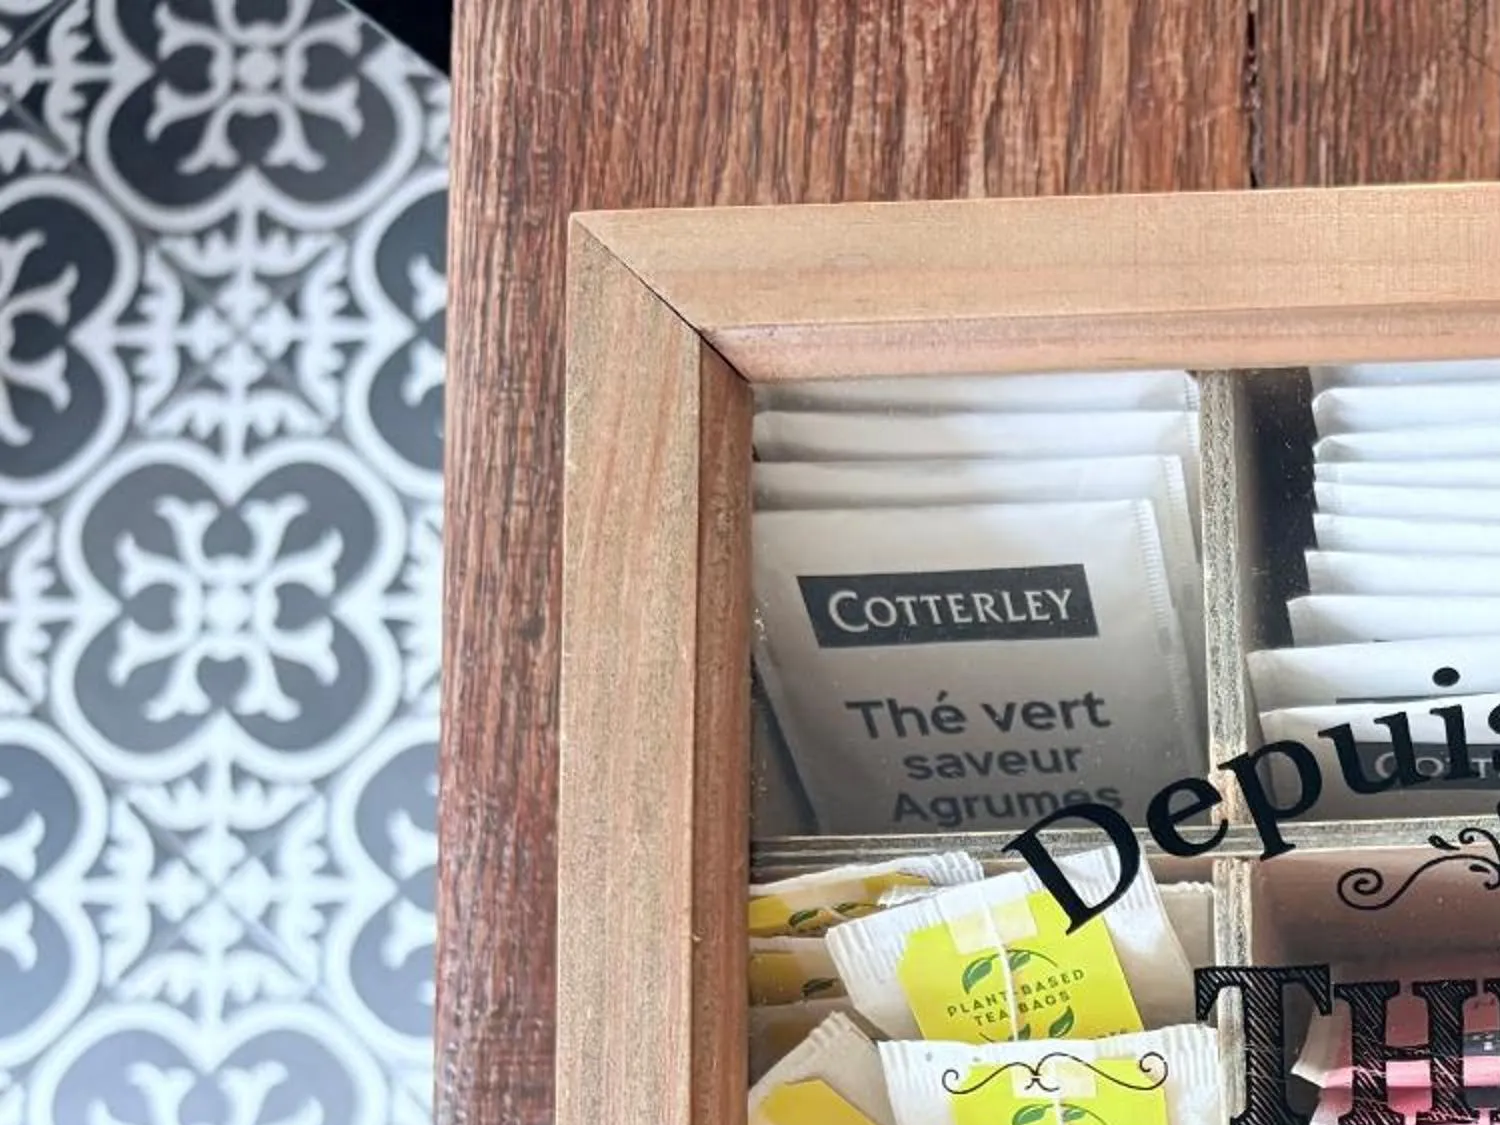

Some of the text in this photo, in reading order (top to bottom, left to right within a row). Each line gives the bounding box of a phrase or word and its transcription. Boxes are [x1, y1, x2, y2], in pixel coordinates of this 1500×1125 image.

[828, 588, 1073, 633] COTTERLEY
[845, 690, 1112, 739] Thé vert
[903, 745, 1083, 780] saveur
[947, 968, 1086, 1017] PLANT-BASED
[973, 990, 1071, 1027] TEA BAGS
